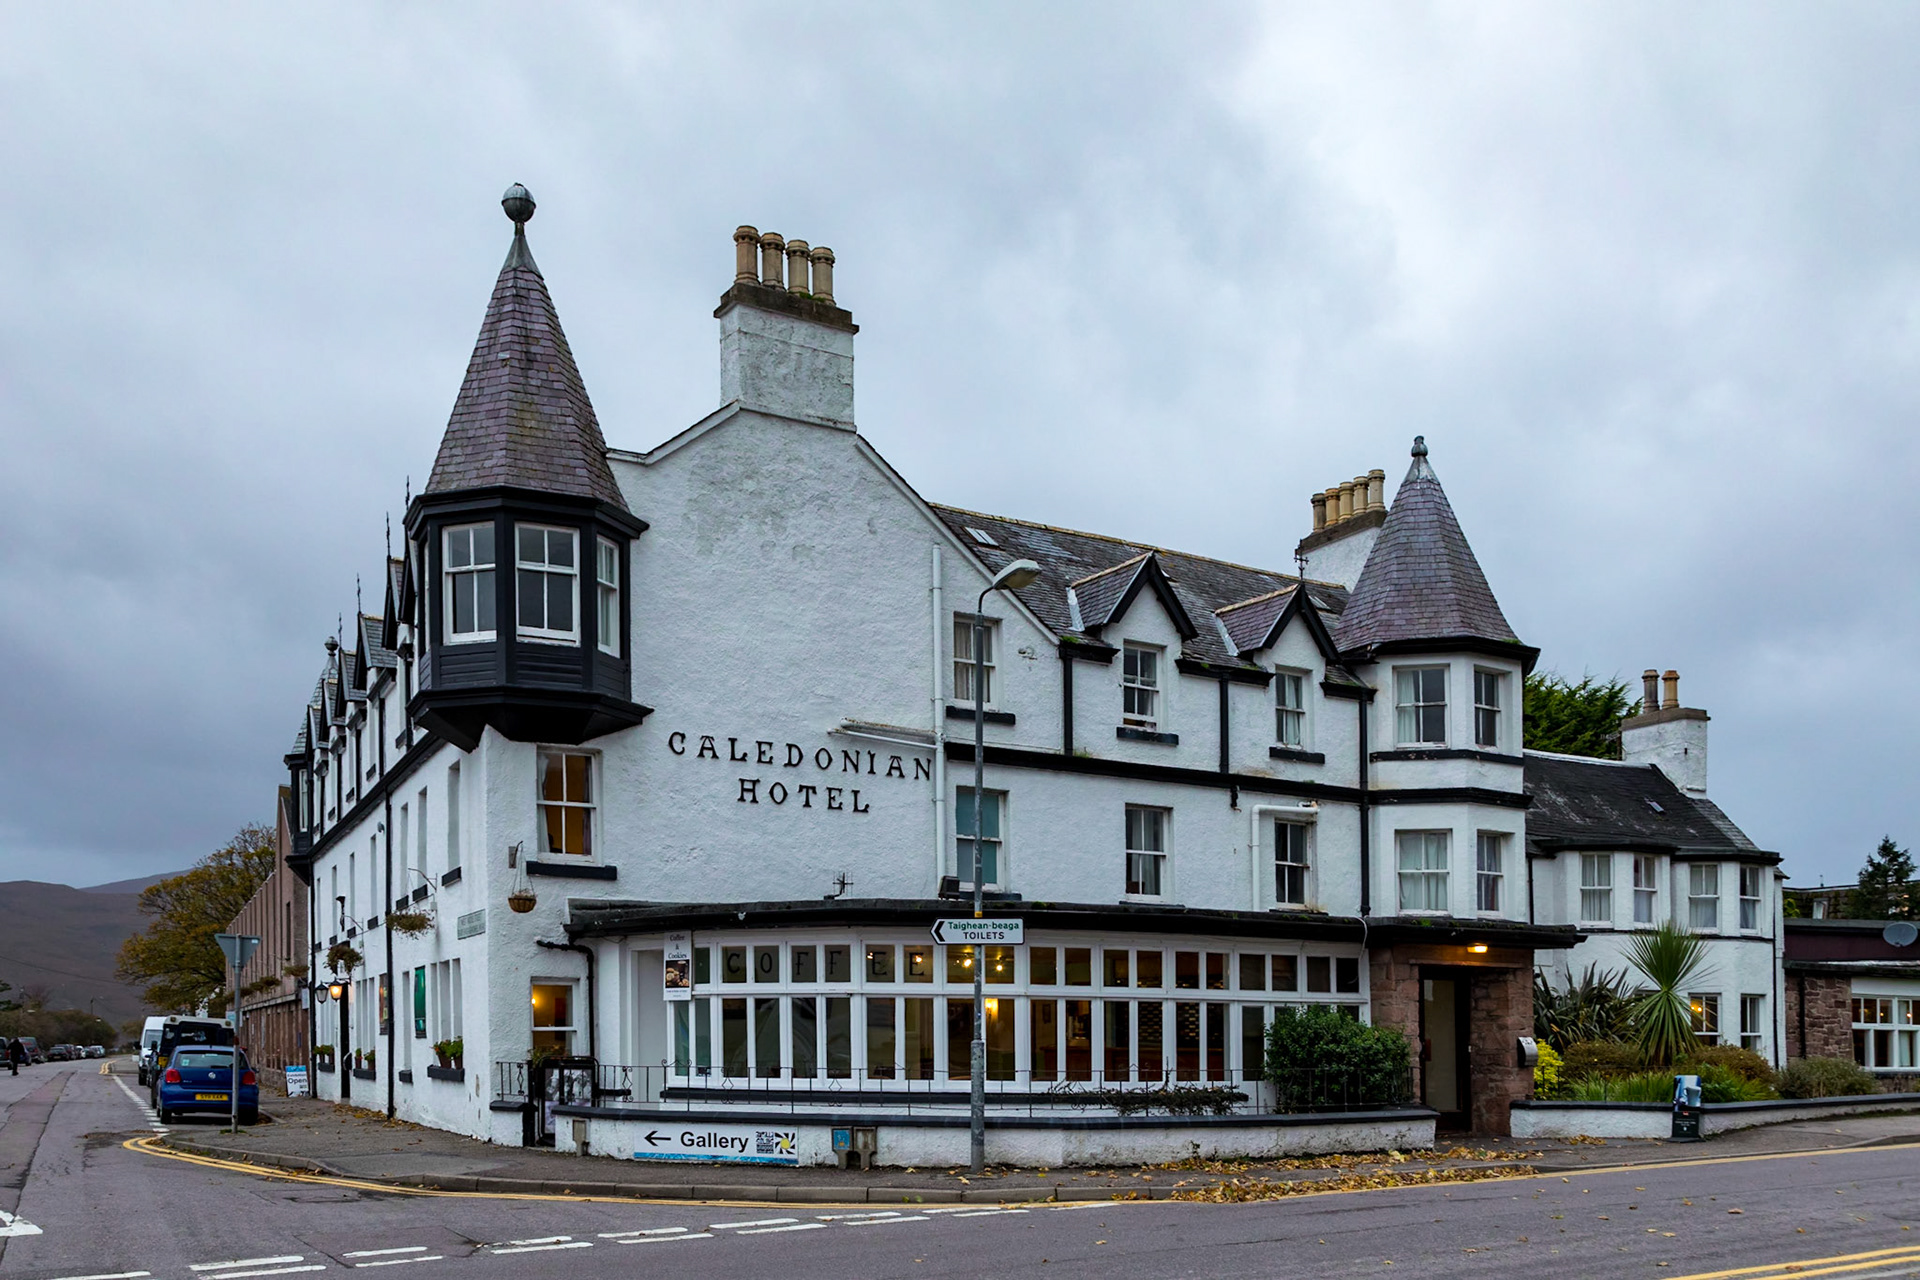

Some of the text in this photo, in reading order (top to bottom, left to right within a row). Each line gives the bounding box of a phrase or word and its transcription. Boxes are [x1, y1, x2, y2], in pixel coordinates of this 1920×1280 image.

[668, 731, 932, 781] CALEDONIAN
[737, 778, 870, 813] HOTEL
[948, 921, 1020, 931] Taighean-beaga
[963, 931, 1005, 940] TOILETS
[680, 1131, 749, 1153] Gallery
